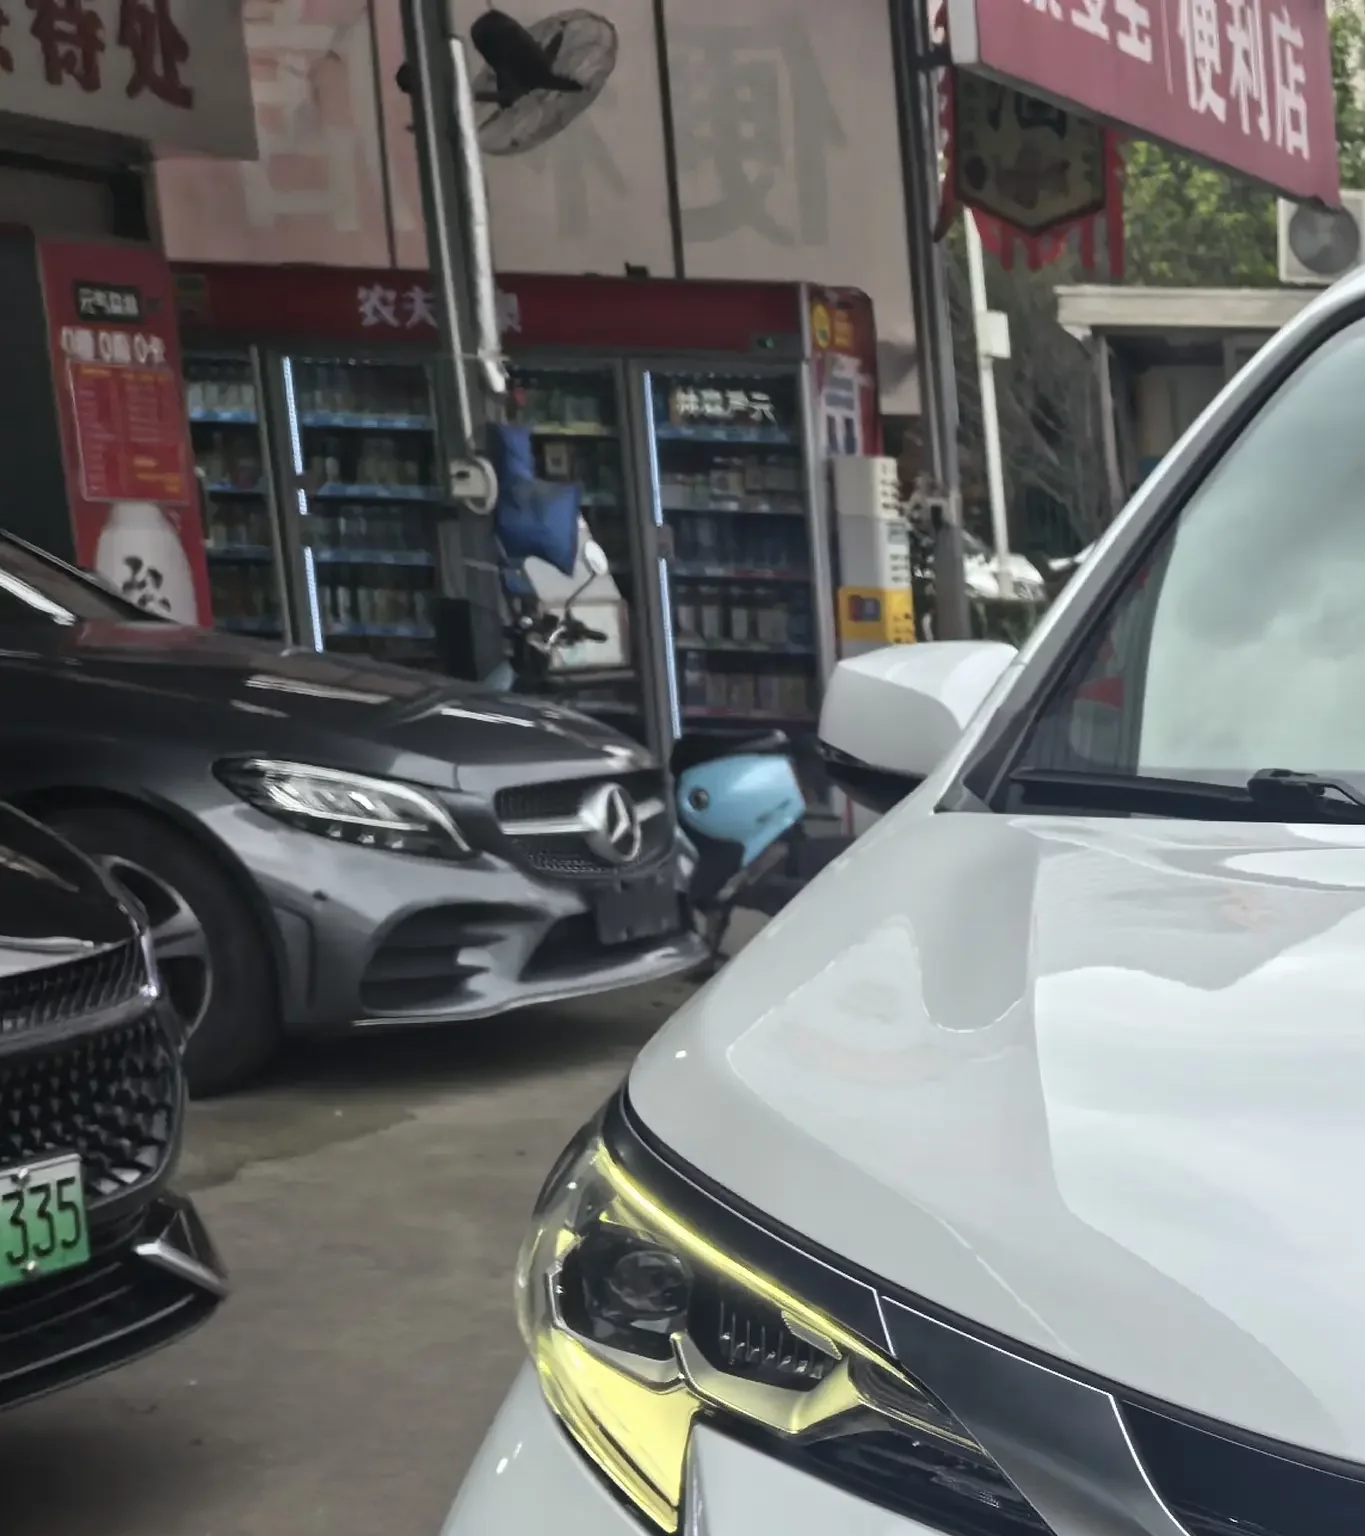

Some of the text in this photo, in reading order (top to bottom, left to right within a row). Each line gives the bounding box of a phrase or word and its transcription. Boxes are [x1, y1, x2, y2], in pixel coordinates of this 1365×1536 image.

[1177, 0, 1310, 161] 便利店
[2, 1176, 81, 1265] 335
